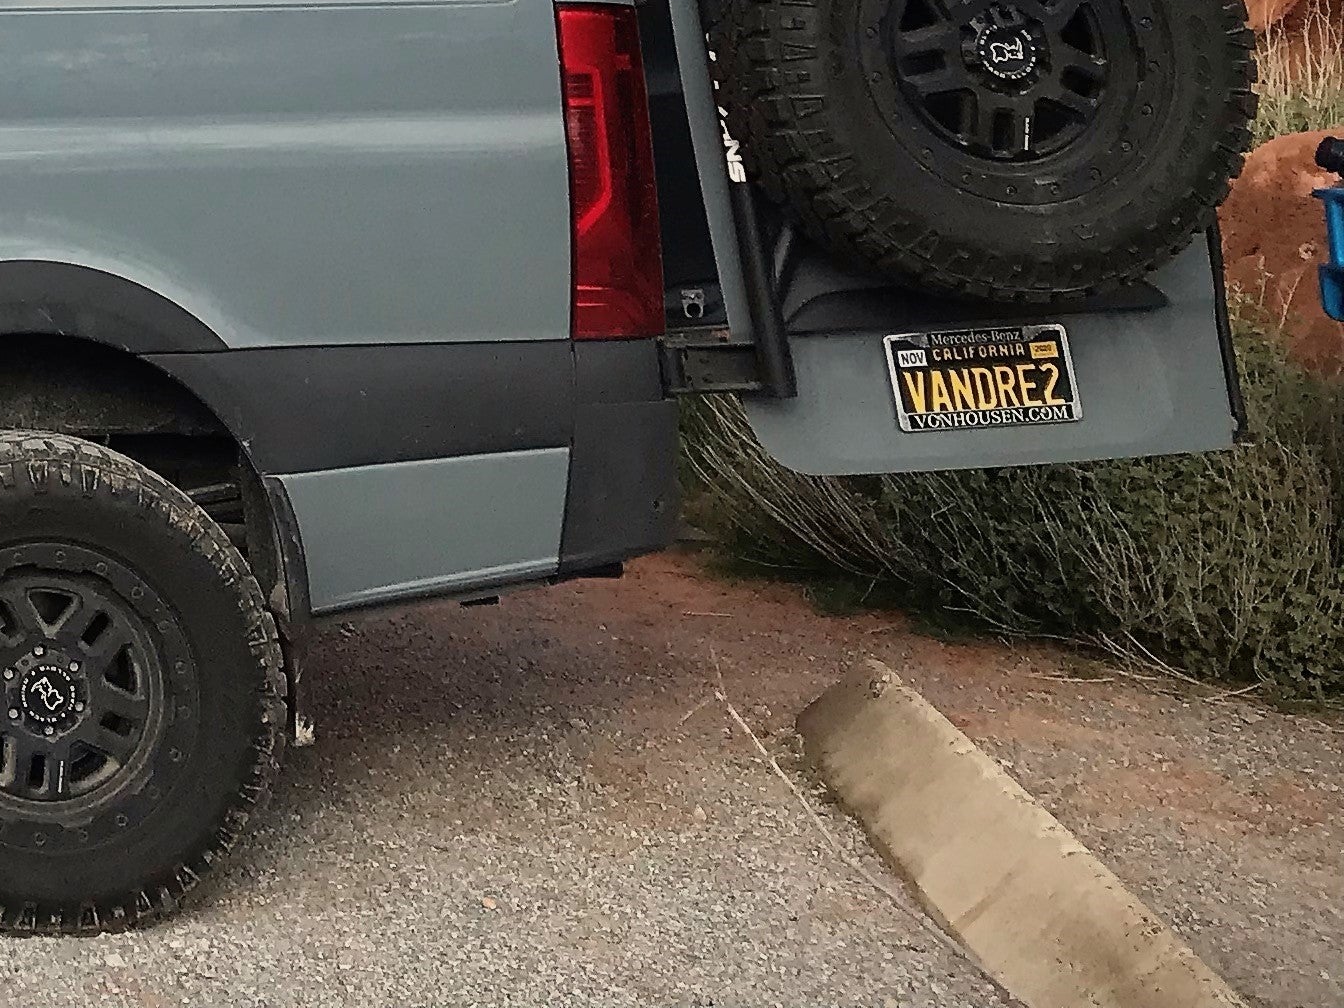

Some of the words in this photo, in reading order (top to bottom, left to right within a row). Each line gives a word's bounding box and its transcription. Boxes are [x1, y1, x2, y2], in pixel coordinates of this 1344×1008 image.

[931, 330, 1021, 345] Mercedes-Benz
[900, 352, 924, 365] NOV
[932, 342, 1025, 361] CALIFORNIA
[902, 362, 1066, 413] VANDRE2
[914, 405, 1069, 429] VONHOUSEN.COM
